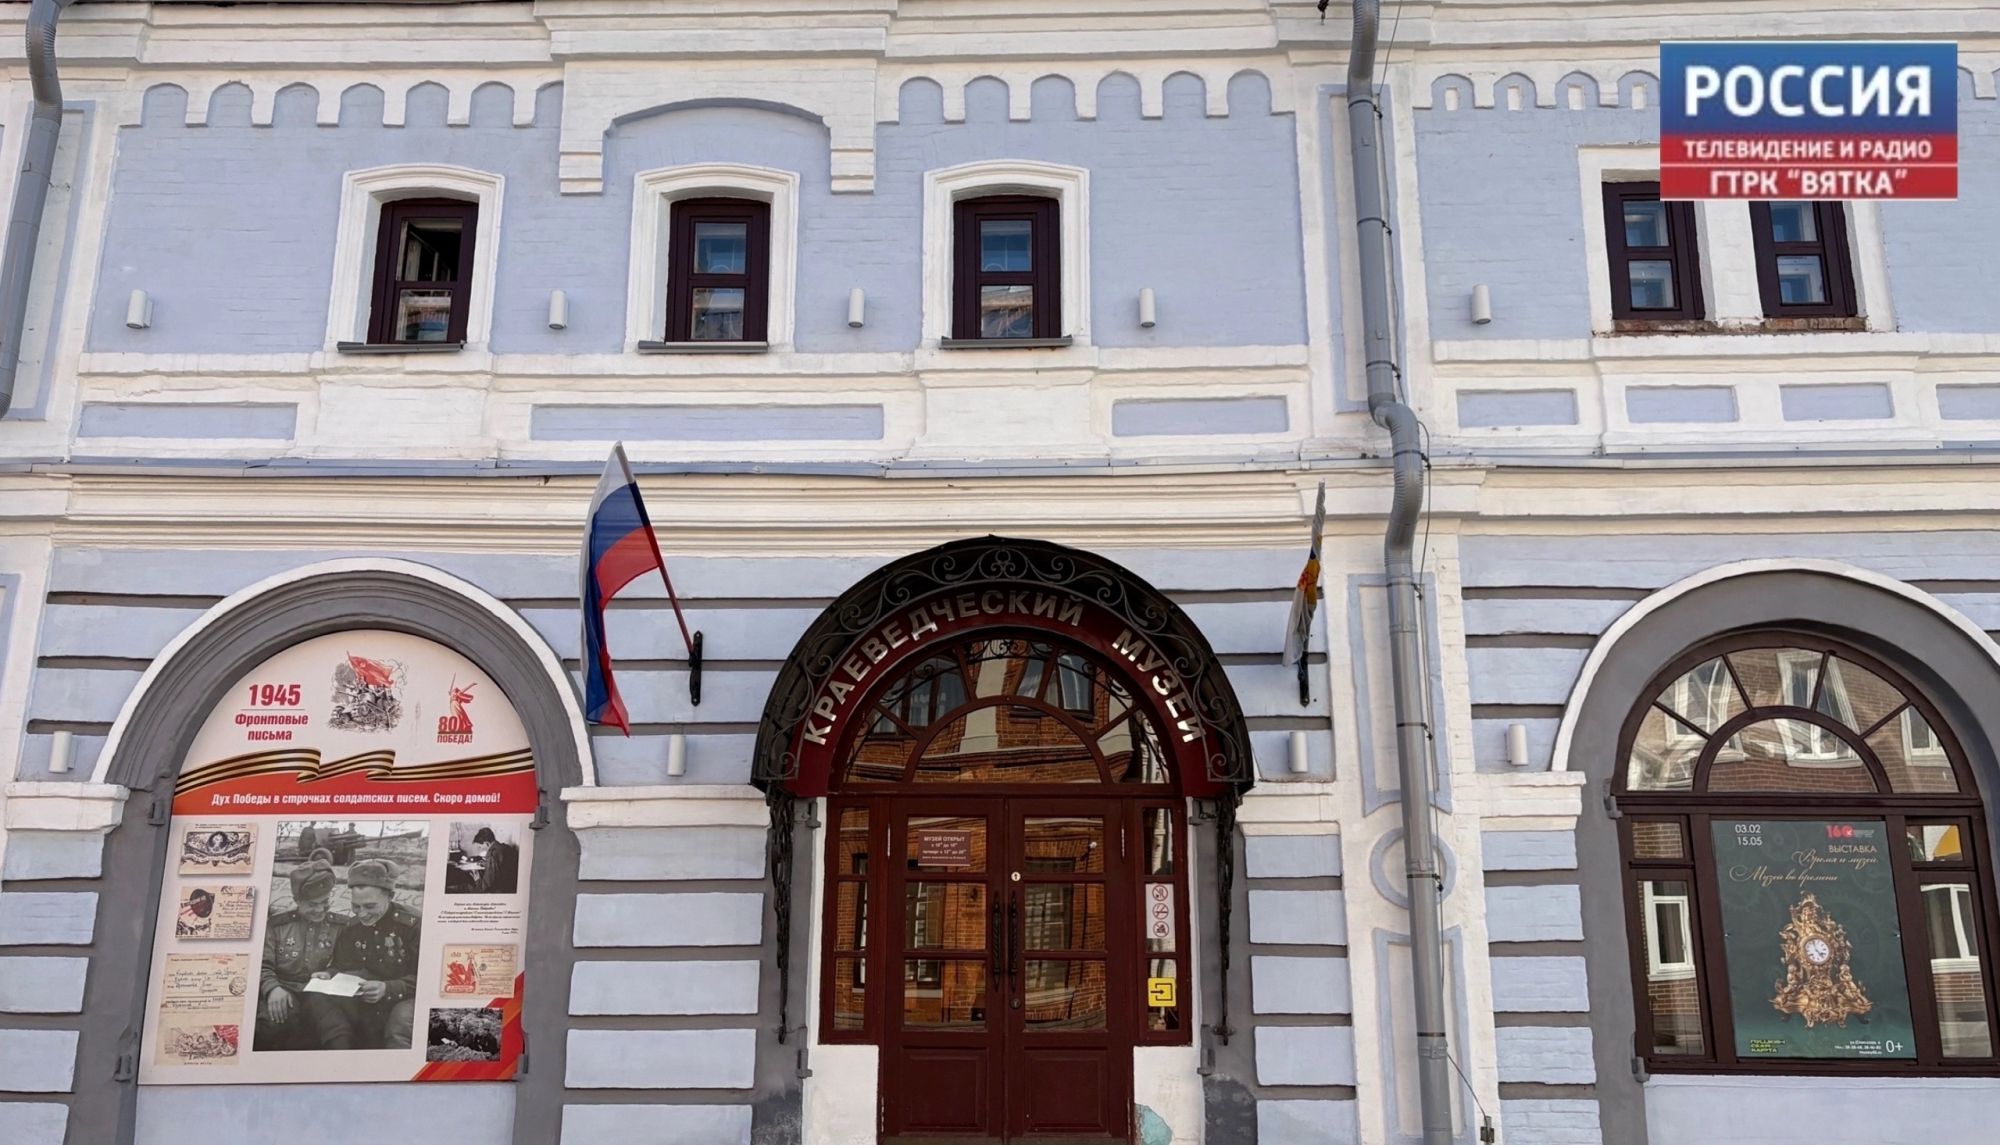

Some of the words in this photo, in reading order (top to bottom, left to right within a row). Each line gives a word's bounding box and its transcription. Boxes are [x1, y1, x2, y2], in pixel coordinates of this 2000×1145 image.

[803, 590, 1085, 746] КРАЕВЕДЧЕСКИЙ
[1111, 628, 1207, 743] МУЗЕЙ
[248, 684, 302, 706] 1945
[235, 713, 309, 727] Фронтовые
[438, 716, 458, 732] 80
[247, 730, 293, 741] письма
[436, 734, 473, 744] ПОБЕДА!
[211, 793, 231, 807] Дух
[232, 793, 272, 805] Победы
[273, 795, 280, 804] в
[281, 794, 331, 807] строчках
[333, 794, 394, 805] солдатских
[396, 794, 431, 804] писем.
[433, 792, 463, 805] Скоро
[464, 792, 501, 805] домой!
[1734, 824, 1761, 834] 03.02
[1736, 836, 1763, 846] 15.05
[1829, 844, 1877, 853] ВЫСТАВКА
[1792, 849, 1838, 869] Время
[1885, 1040, 1904, 1053] 0+
